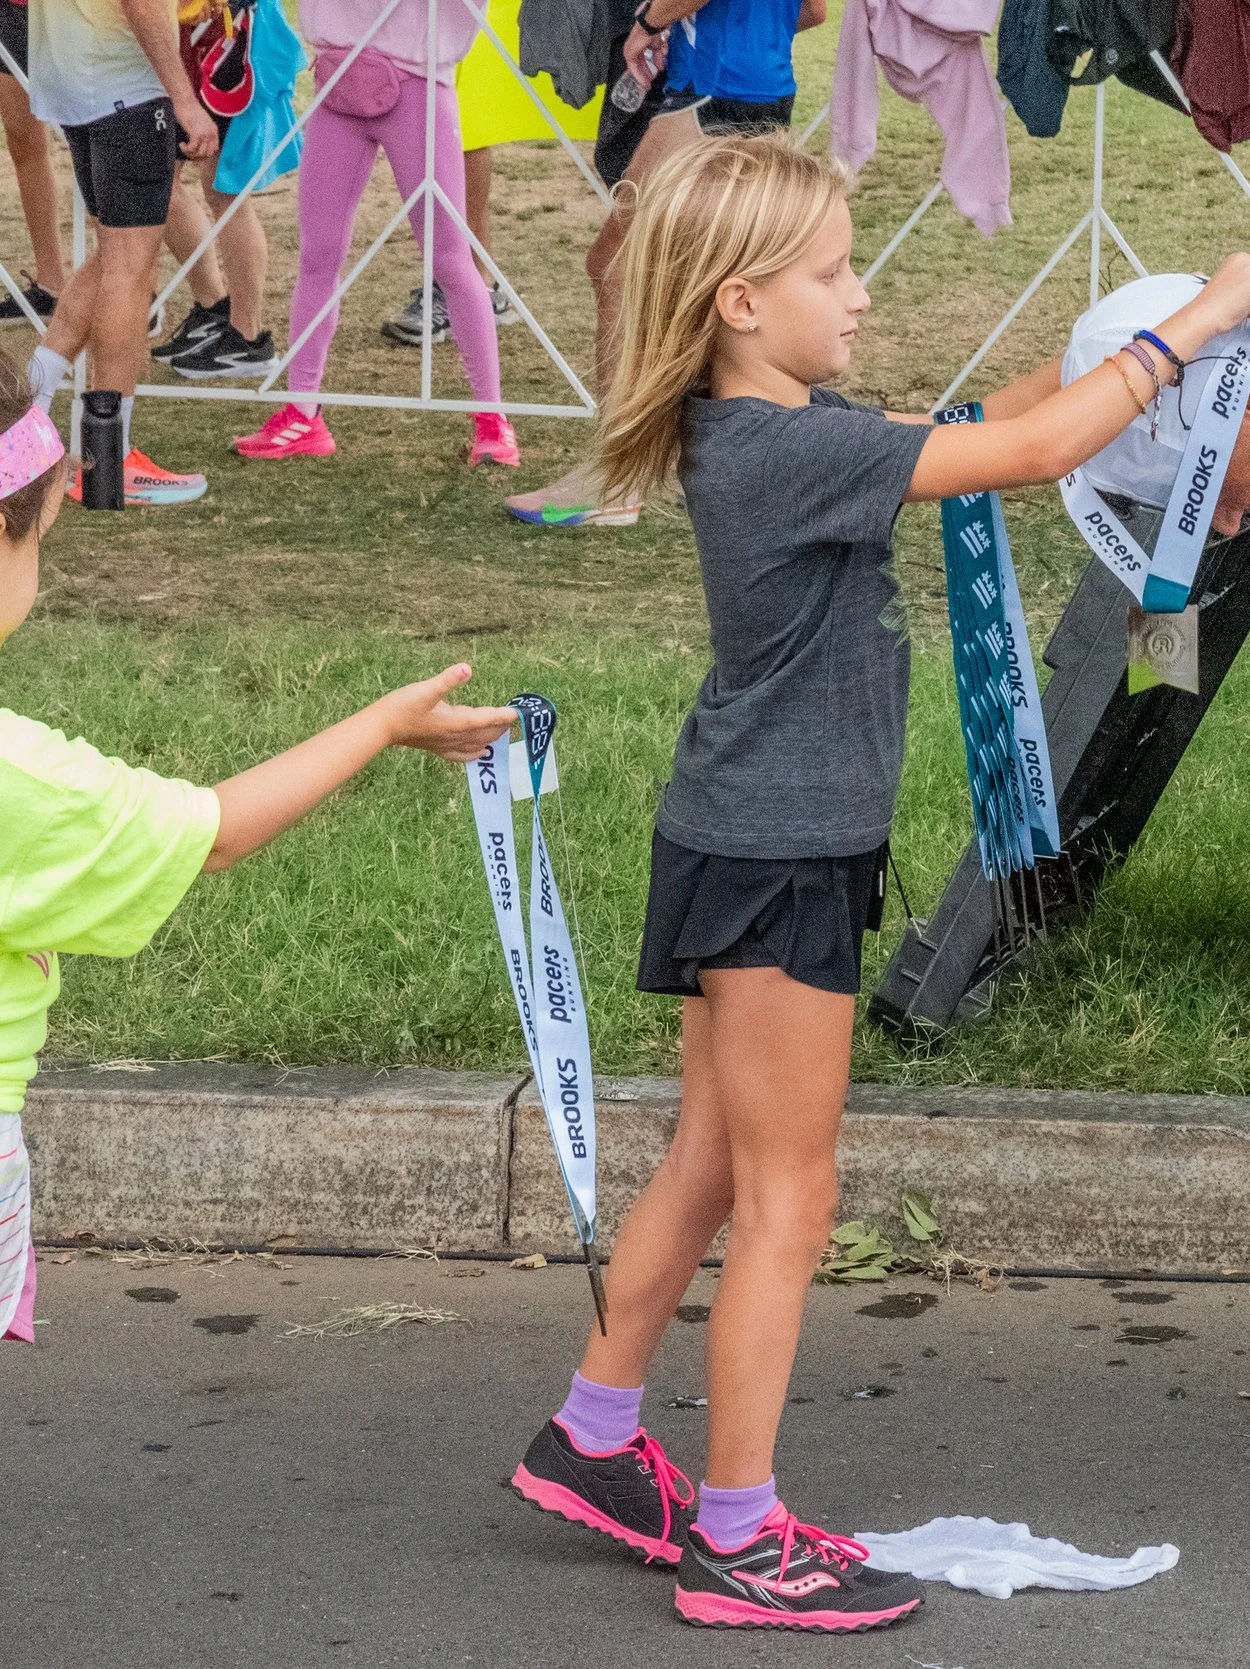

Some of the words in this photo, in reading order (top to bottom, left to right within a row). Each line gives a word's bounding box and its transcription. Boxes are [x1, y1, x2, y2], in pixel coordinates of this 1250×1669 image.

[1211, 346, 1247, 419] pacers
[133, 475, 189, 487] BROOKS
[1178, 444, 1218, 536] BROOKS
[1084, 511, 1142, 571] pacers
[1019, 738, 1047, 809] pacers
[488, 832, 512, 911] pacers
[511, 949, 539, 1051] BROOKS
[544, 945, 572, 1023] pacers
[557, 1057, 587, 1158] BROOKS
